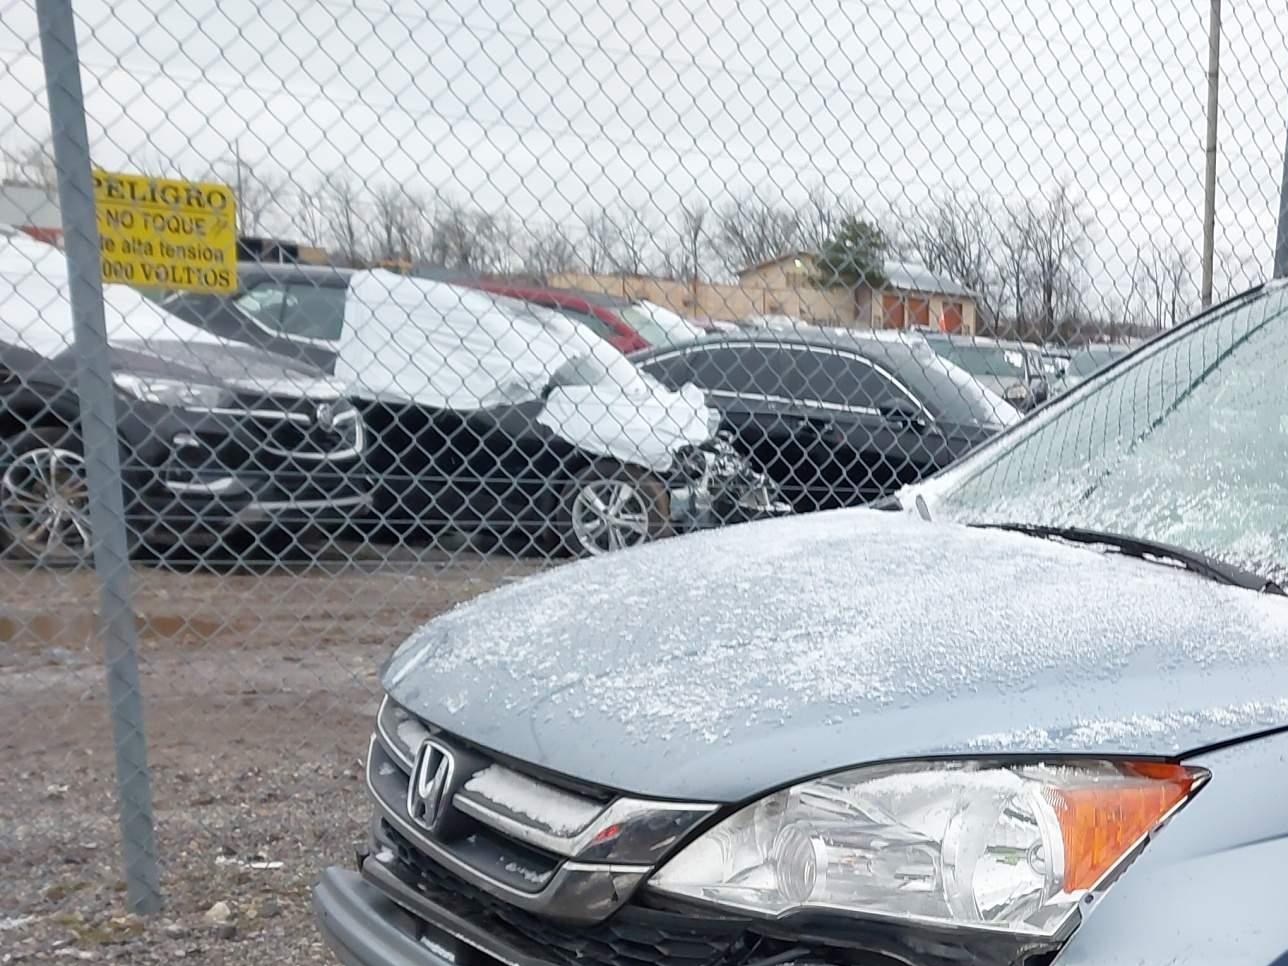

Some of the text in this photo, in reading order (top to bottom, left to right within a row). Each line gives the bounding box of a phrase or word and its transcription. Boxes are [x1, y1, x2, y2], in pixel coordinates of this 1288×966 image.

[105, 209, 207, 236] NO TOQUE
[121, 236, 154, 257] alta
[140, 263, 231, 288] VOLTIOS
